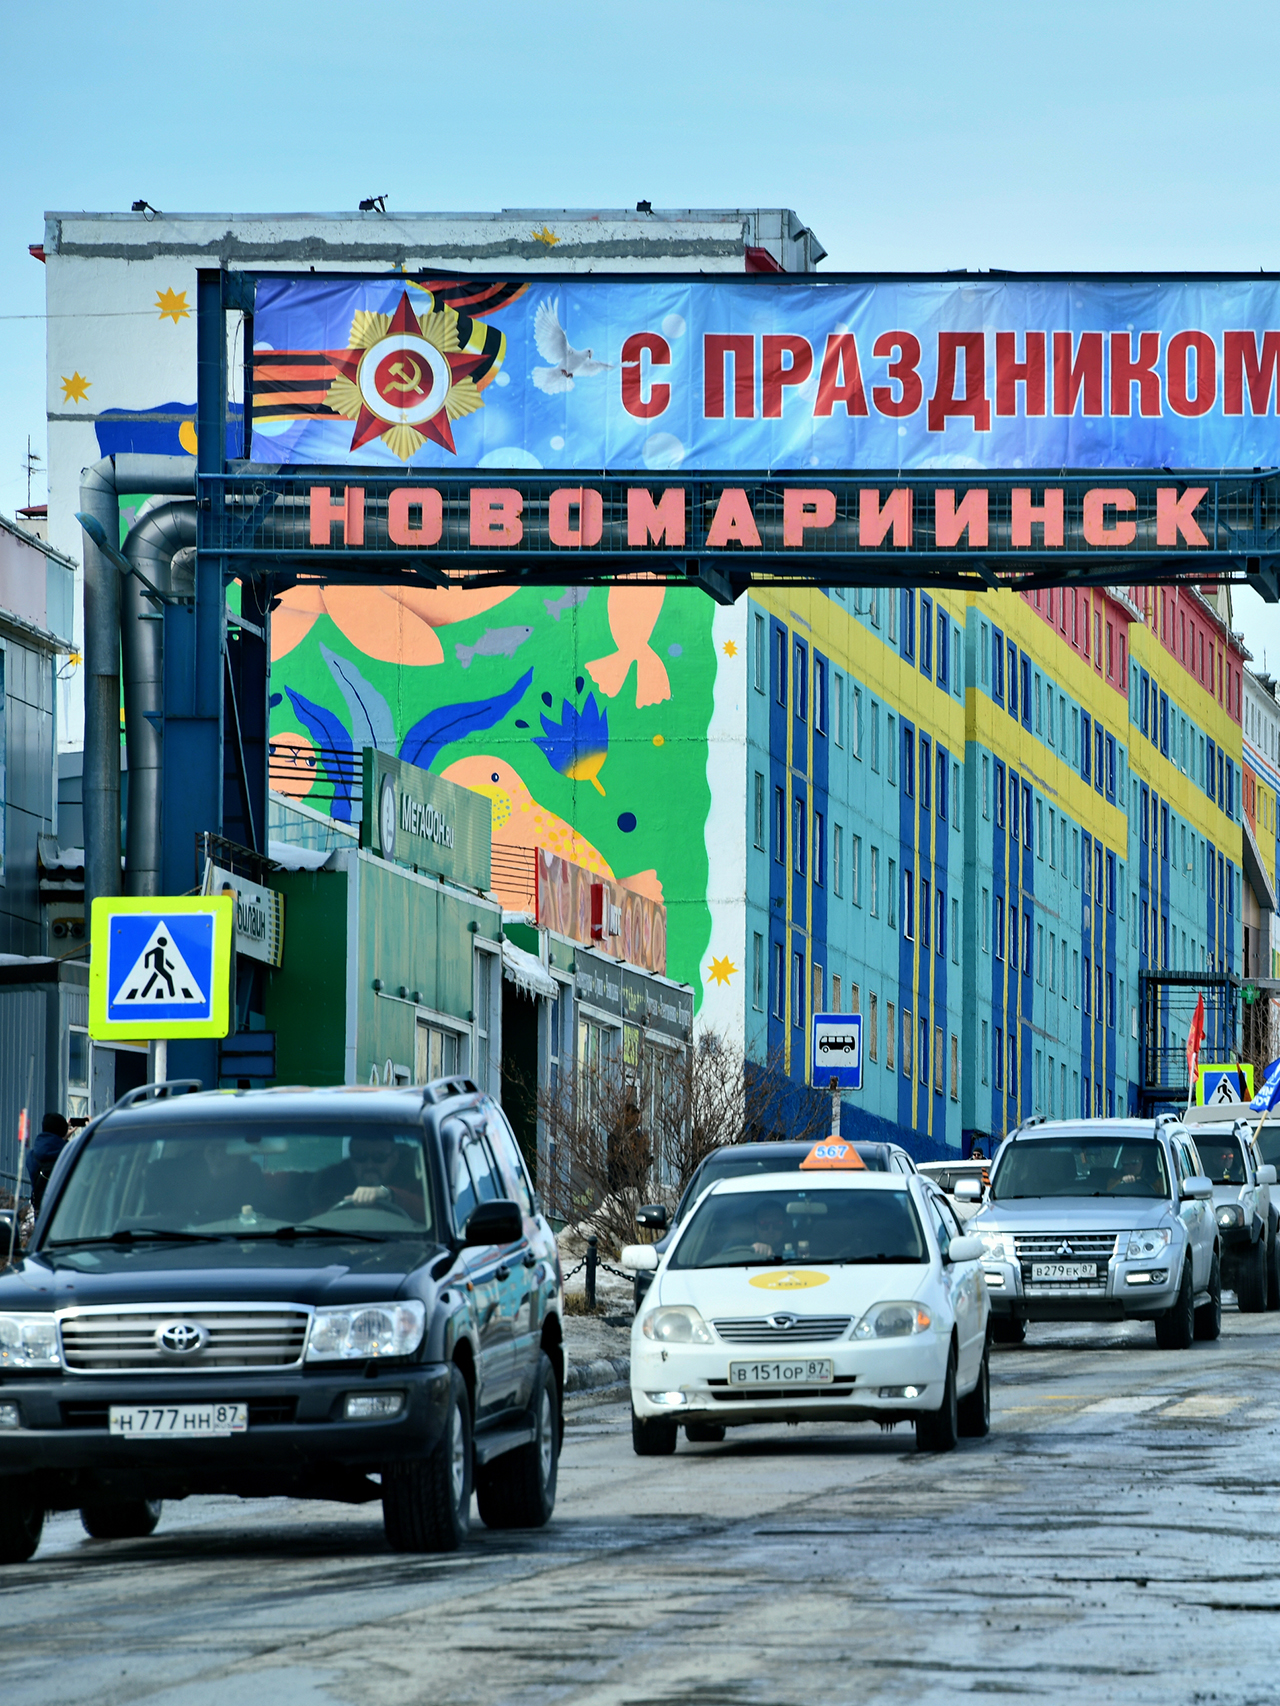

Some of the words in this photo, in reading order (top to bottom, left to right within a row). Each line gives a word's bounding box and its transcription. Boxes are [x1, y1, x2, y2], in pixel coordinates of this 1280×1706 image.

[621, 331, 672, 419] С
[309, 486, 1210, 547] НОВОМАРИИНСК
[814, 1144, 849, 1159] 567
[808, 1362, 825, 1374] 87
[217, 1406, 239, 1422] 87
